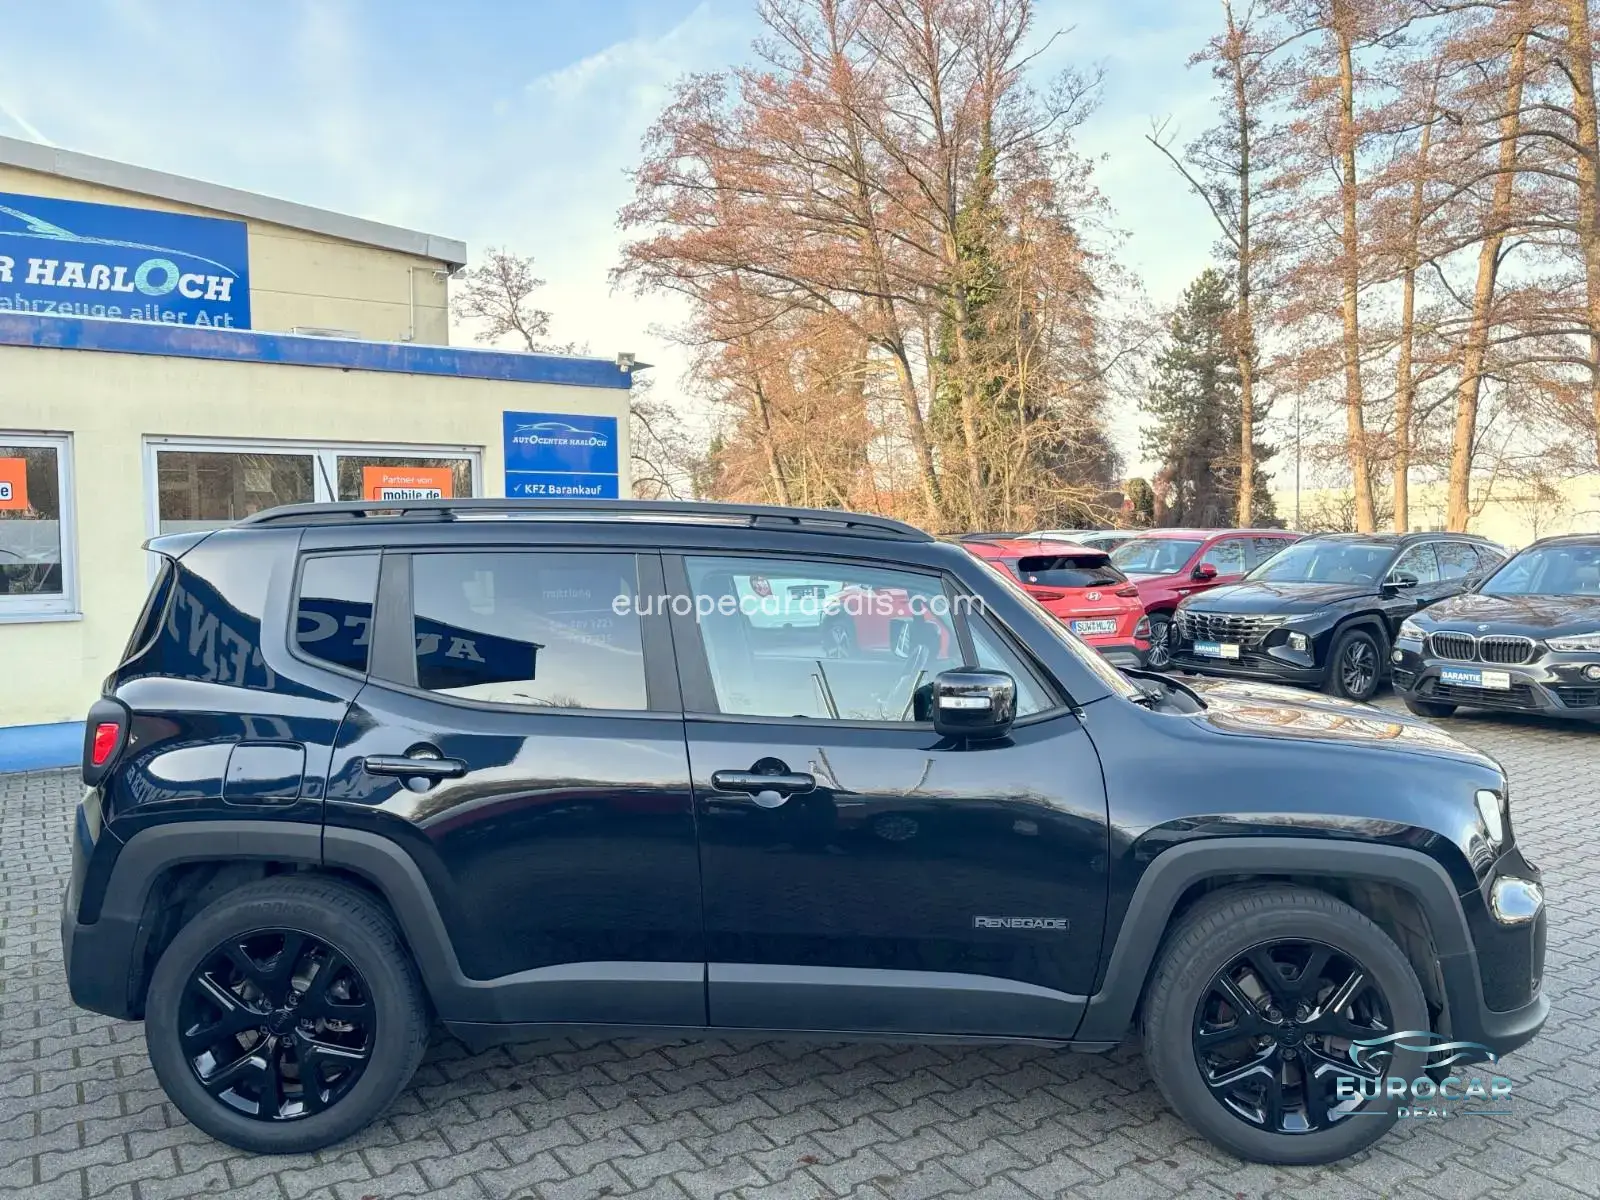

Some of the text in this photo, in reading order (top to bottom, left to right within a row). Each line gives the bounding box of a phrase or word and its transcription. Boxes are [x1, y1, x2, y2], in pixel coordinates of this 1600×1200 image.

[25, 258, 234, 302] HAßLOCH
[195, 312, 234, 328] Art
[512, 435, 568, 445] AUTOCENTER
[383, 475, 415, 484] Partner
[383, 490, 440, 500] mobilede
[525, 484, 602, 495] KFZ Barankauf
[1442, 671, 1481, 682] GARANTIE
[974, 917, 1067, 929] RENEGADE
